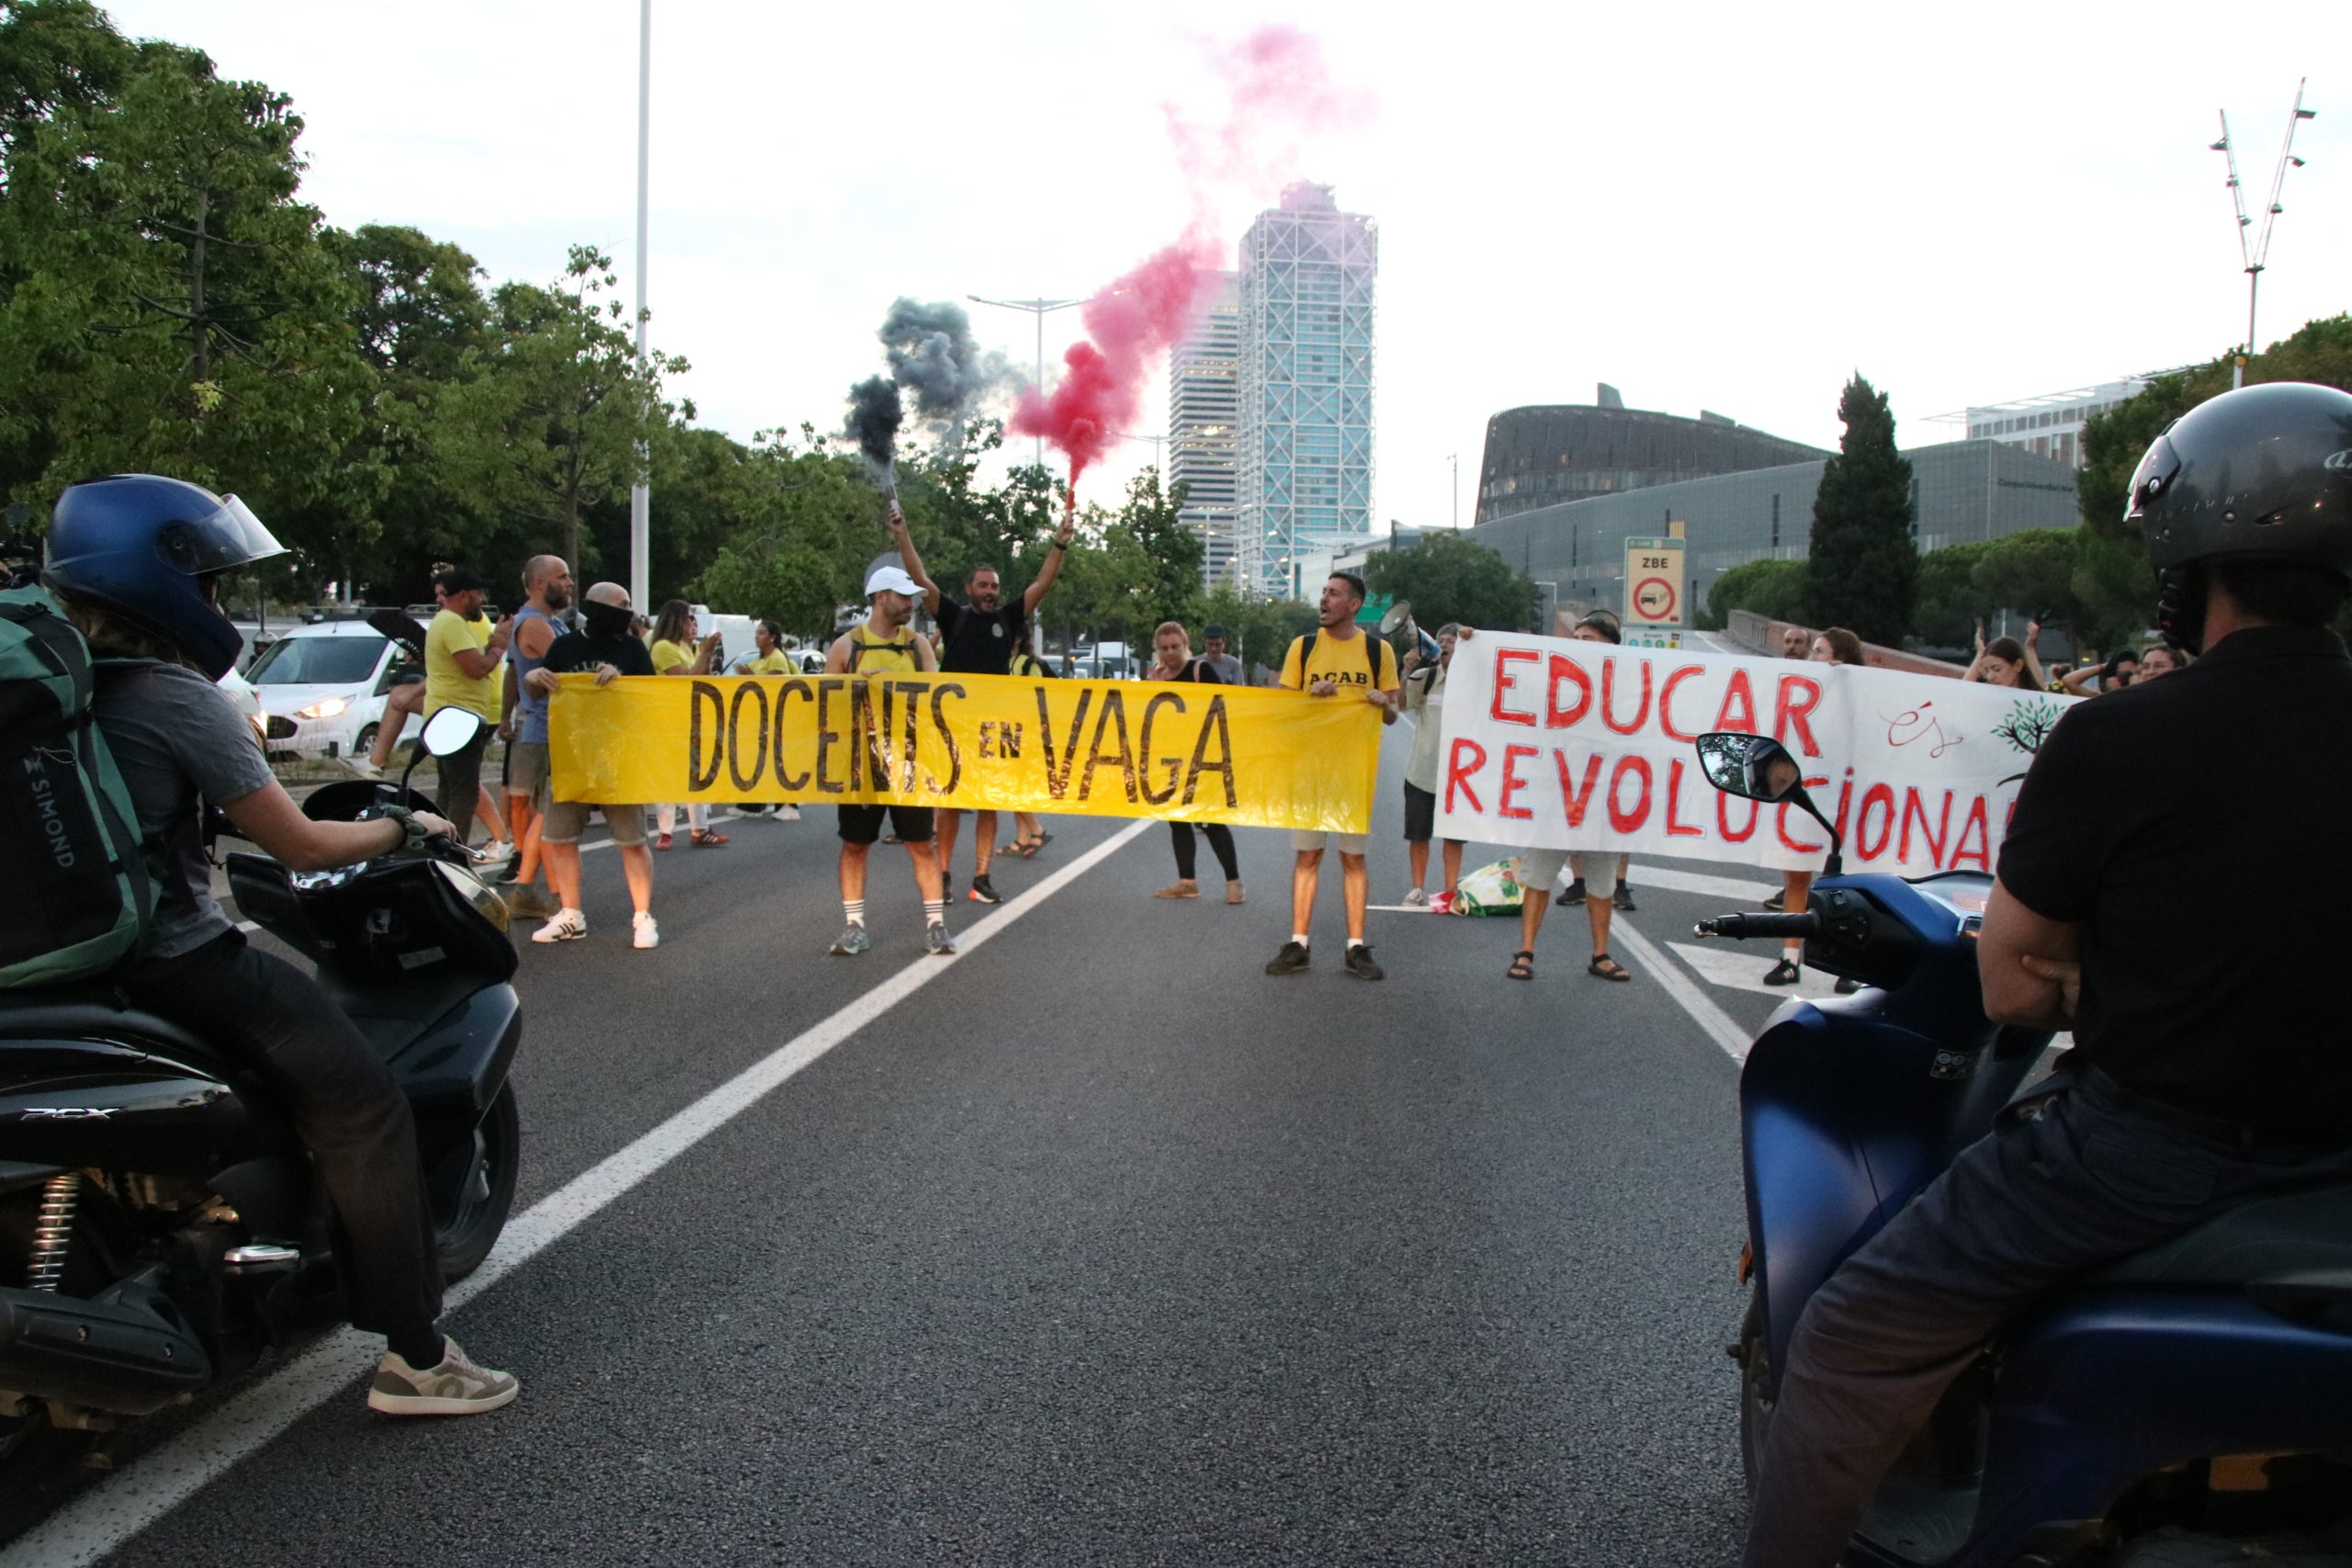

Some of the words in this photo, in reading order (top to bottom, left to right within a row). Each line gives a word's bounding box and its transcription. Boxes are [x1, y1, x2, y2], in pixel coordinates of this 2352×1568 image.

[1642, 558, 1668, 569] ZBE
[1309, 671, 1367, 685] ACAB
[1490, 647, 1823, 759] EDUCAR
[1878, 701, 1963, 759] és
[688, 680, 966, 795] DOCENTS
[978, 721, 1023, 759] EN
[1035, 686, 1238, 808] VAGA
[31, 779, 74, 868] SIMOND
[20, 1107, 119, 1121] PCX
